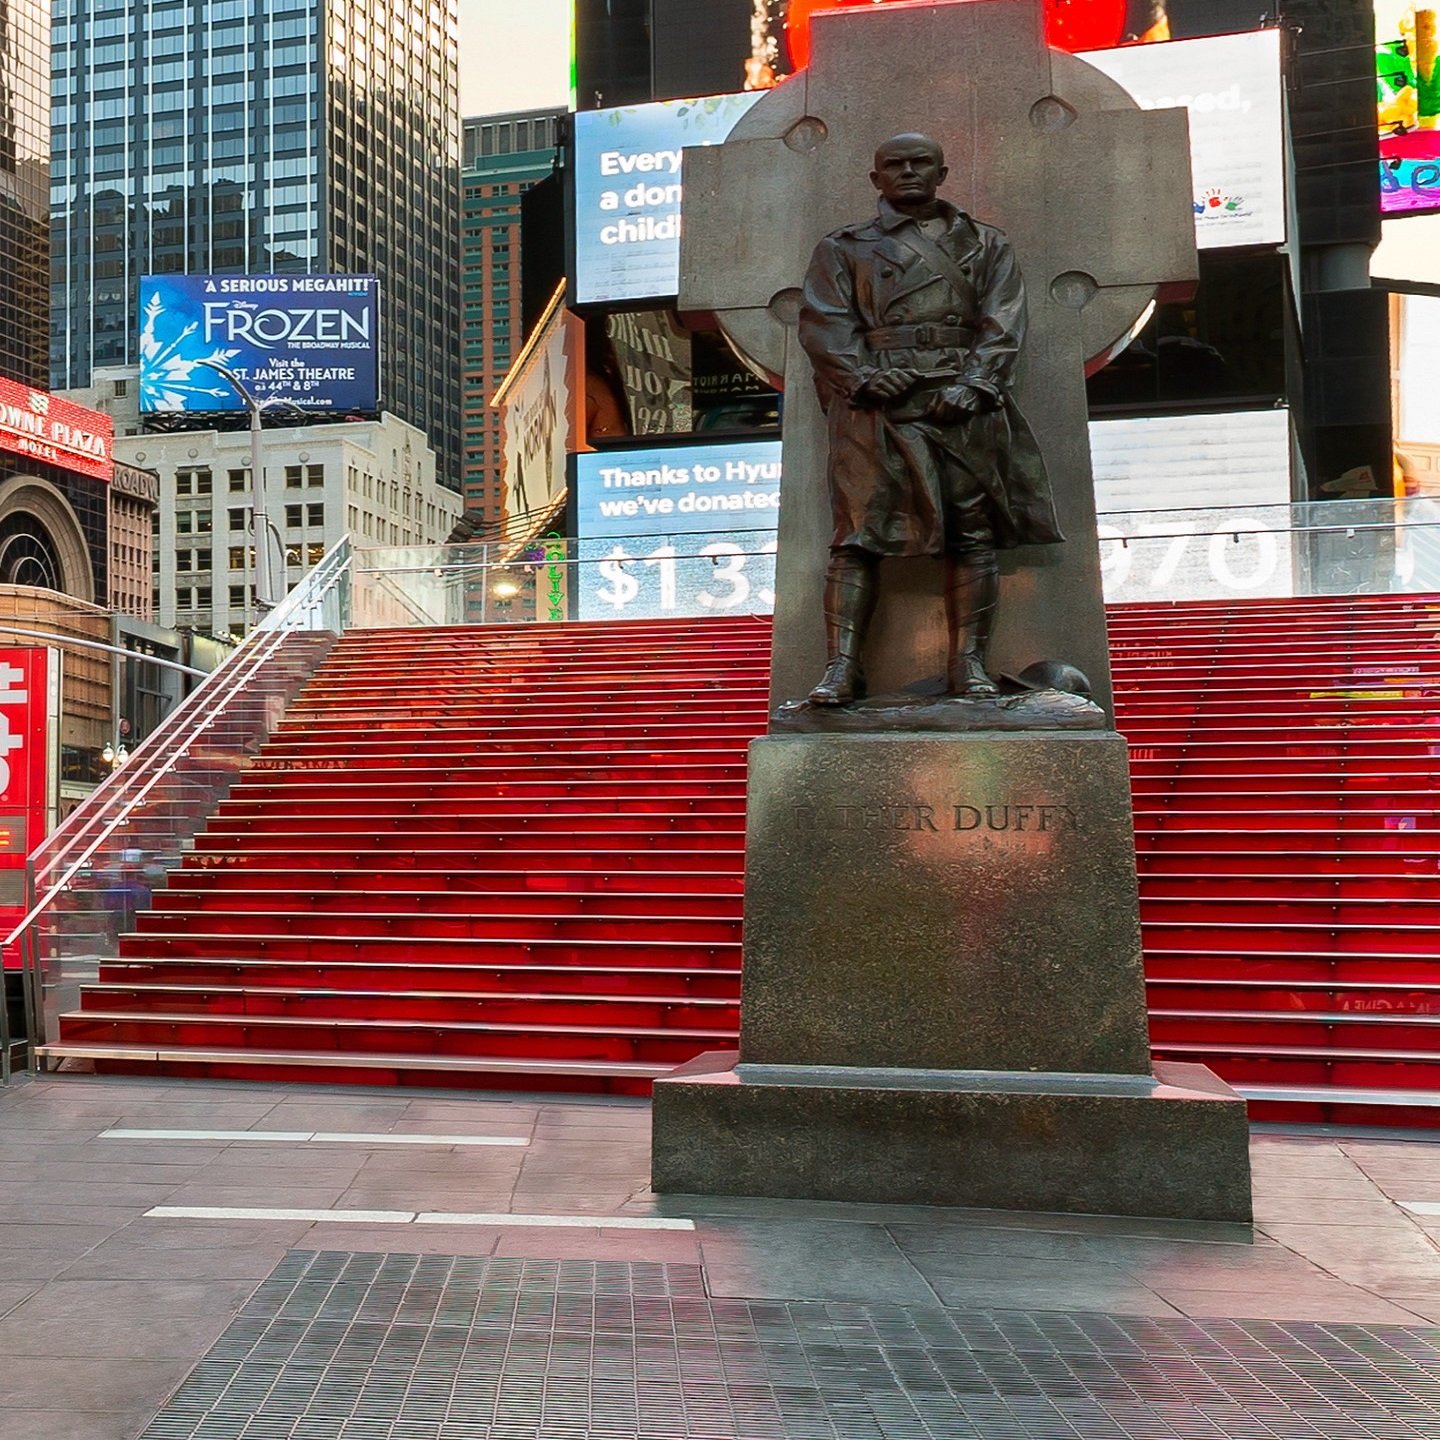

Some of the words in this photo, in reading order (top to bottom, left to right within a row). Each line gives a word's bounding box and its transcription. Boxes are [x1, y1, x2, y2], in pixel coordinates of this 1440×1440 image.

[600, 193, 619, 211] a
[219, 279, 288, 293] SERIOUS
[203, 301, 369, 349] FROZEN
[340, 342, 371, 350] MUSICAL
[269, 358, 289, 368] Visit
[290, 358, 305, 368] the
[234, 369, 249, 380] ST.
[252, 368, 294, 380] JAMES
[298, 368, 355, 380] THEATRE
[51, 421, 107, 456] PLAZA
[19, 439, 58, 460] HOTEL
[600, 463, 689, 487] Thanks
[692, 464, 721, 484] to
[600, 490, 673, 516] we've
[953, 804, 1081, 833] DUFFY
